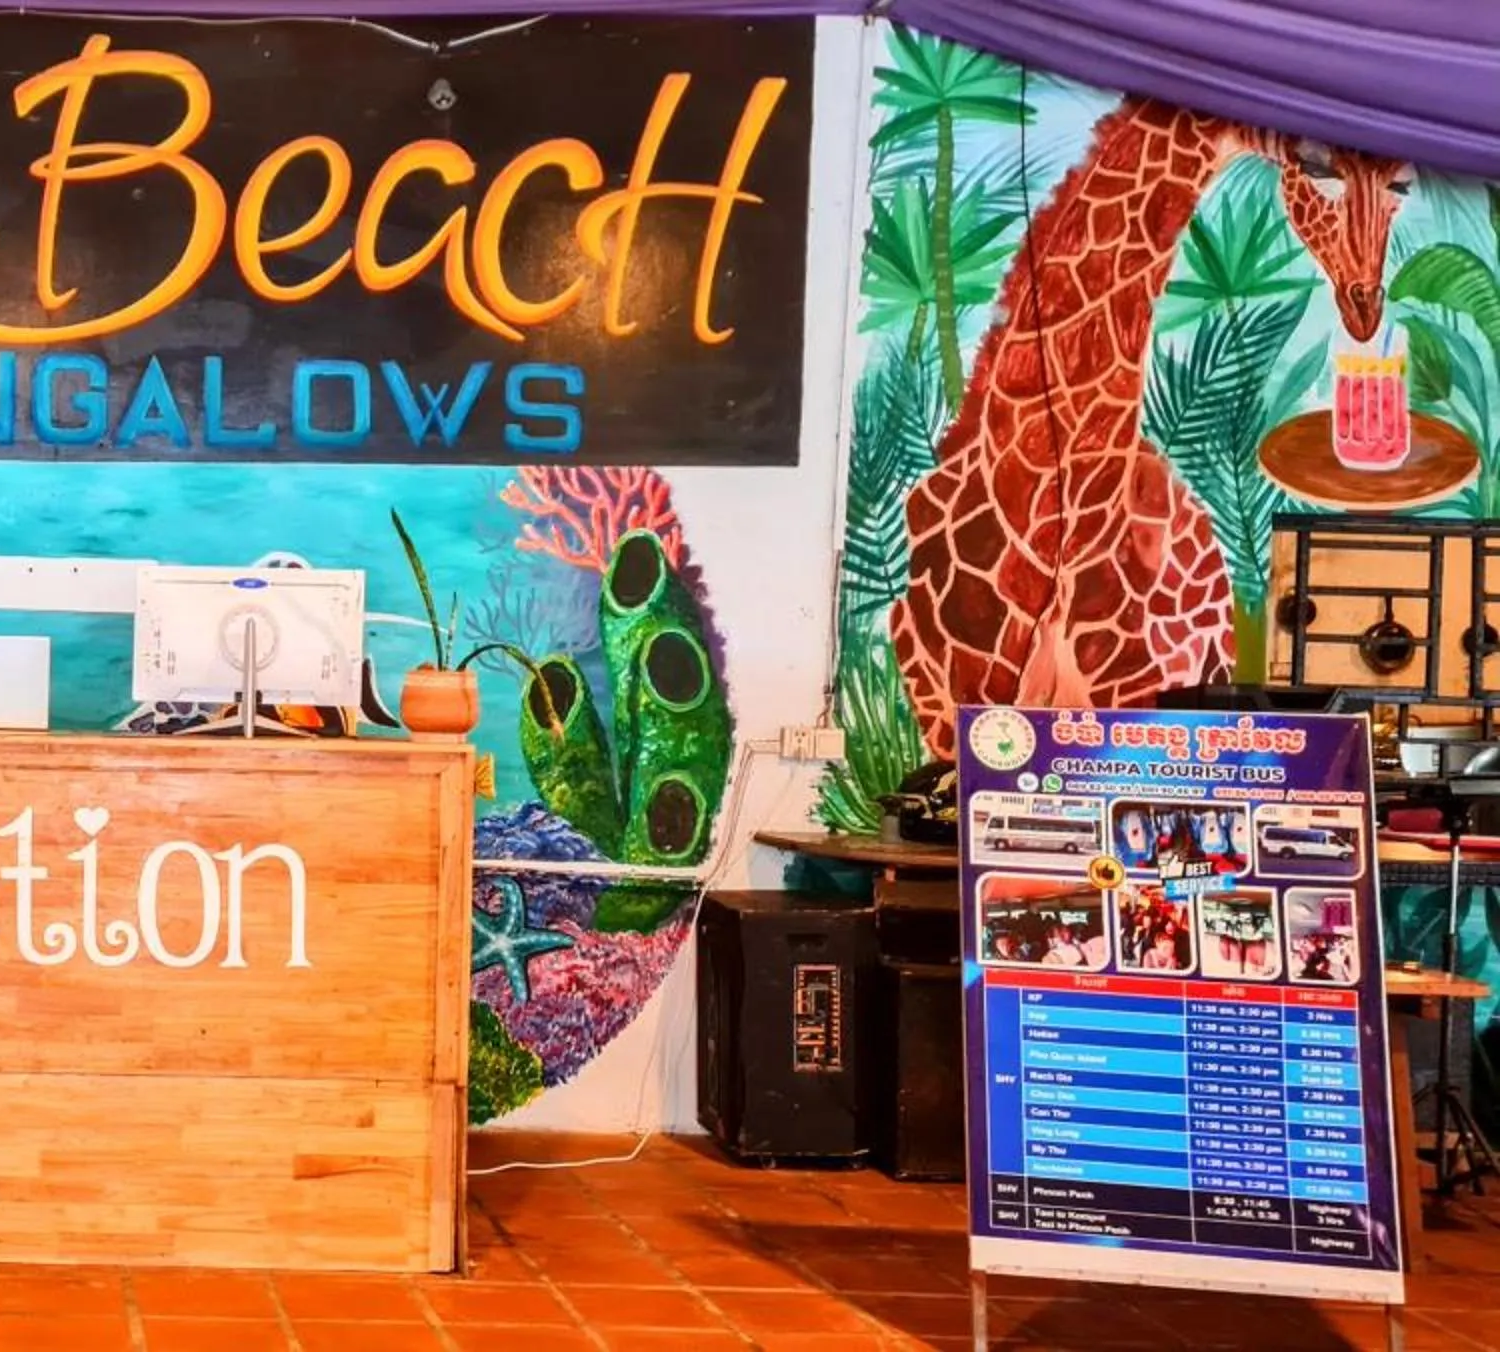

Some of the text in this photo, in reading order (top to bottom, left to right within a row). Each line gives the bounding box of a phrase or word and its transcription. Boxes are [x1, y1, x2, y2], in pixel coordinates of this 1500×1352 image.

[1052, 758, 1285, 782] CHAMPA TOURIST BUS
[1186, 861, 1212, 876] BEST
[1262, 1010, 1278, 1020] pm
[1262, 1028, 1279, 1038] pm
[1262, 1047, 1279, 1057] pm
[1263, 1068, 1280, 1078] pm
[1263, 1088, 1280, 1098] pm
[1325, 1092, 1344, 1102] Hrs
[1264, 1108, 1281, 1118] pm
[1264, 1126, 1281, 1136] pm
[1327, 1129, 1347, 1139] Hrs
[1266, 1145, 1283, 1155] pm
[1266, 1163, 1283, 1173] pm
[1268, 1182, 1284, 1192] pm
[1056, 1210, 1067, 1219] to
[1307, 1203, 1352, 1217] Highway
[1056, 1221, 1067, 1230] to
[1325, 1217, 1345, 1226] Hrs
[1310, 1236, 1355, 1250] Highway
